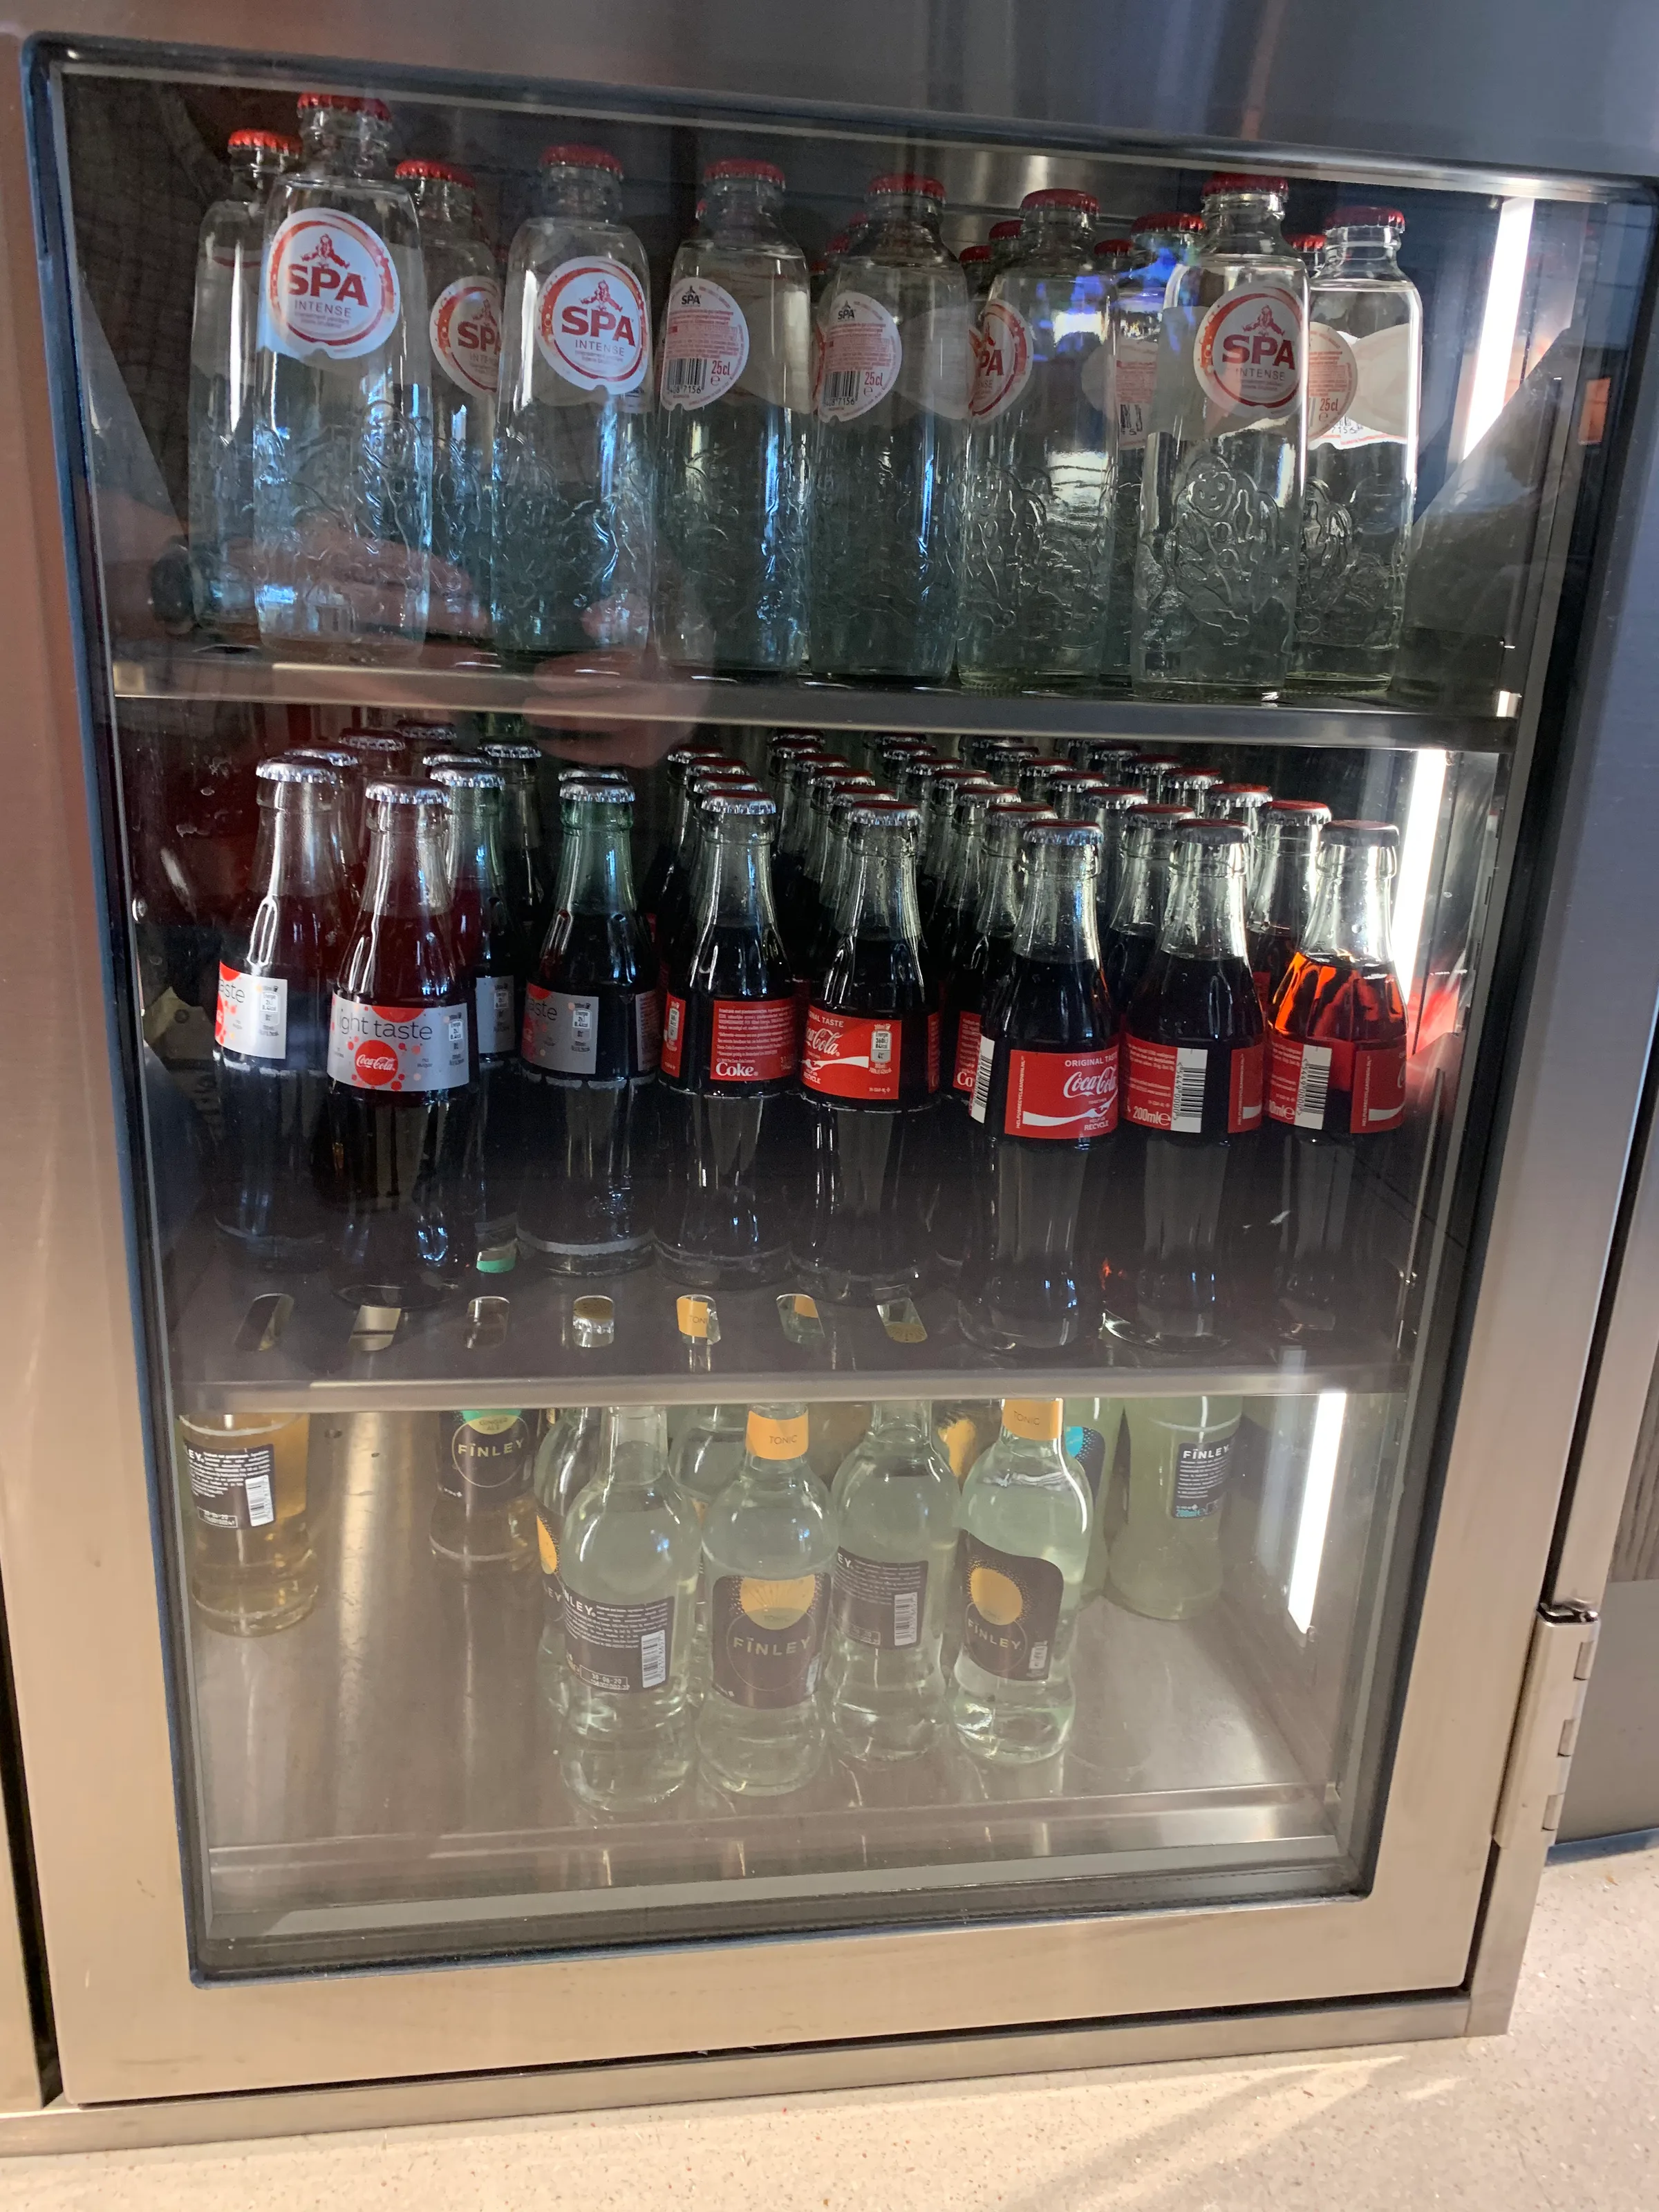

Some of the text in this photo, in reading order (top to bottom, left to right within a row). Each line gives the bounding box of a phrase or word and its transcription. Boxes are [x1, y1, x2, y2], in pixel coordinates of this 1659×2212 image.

[288, 263, 368, 307] SPA
[681, 294, 701, 305] SPA
[295, 300, 351, 318] INTENSE
[838, 309, 855, 320] SPA
[561, 306, 636, 347] SPA
[575, 339, 625, 357] INTENSE
[1222, 334, 1295, 371] SPA
[711, 360, 731, 375] 25cl
[978, 349, 1004, 376] PA
[865, 371, 883, 386] 25cl
[1236, 368, 1286, 381] INTENSE
[1320, 398, 1338, 411] 25cl
[218, 979, 245, 1004] aste
[373, 1020, 433, 1040] taste
[821, 1017, 844, 1028] TASTE
[716, 1062, 754, 1076] Coke
[1065, 1057, 1104, 1067] ORIGINAL
[957, 1071, 973, 1087] Co
[1084, 1121, 1109, 1131] RECYCLE
[1013, 1410, 1040, 1425] TONIC
[769, 1434, 798, 1445] TONIC
